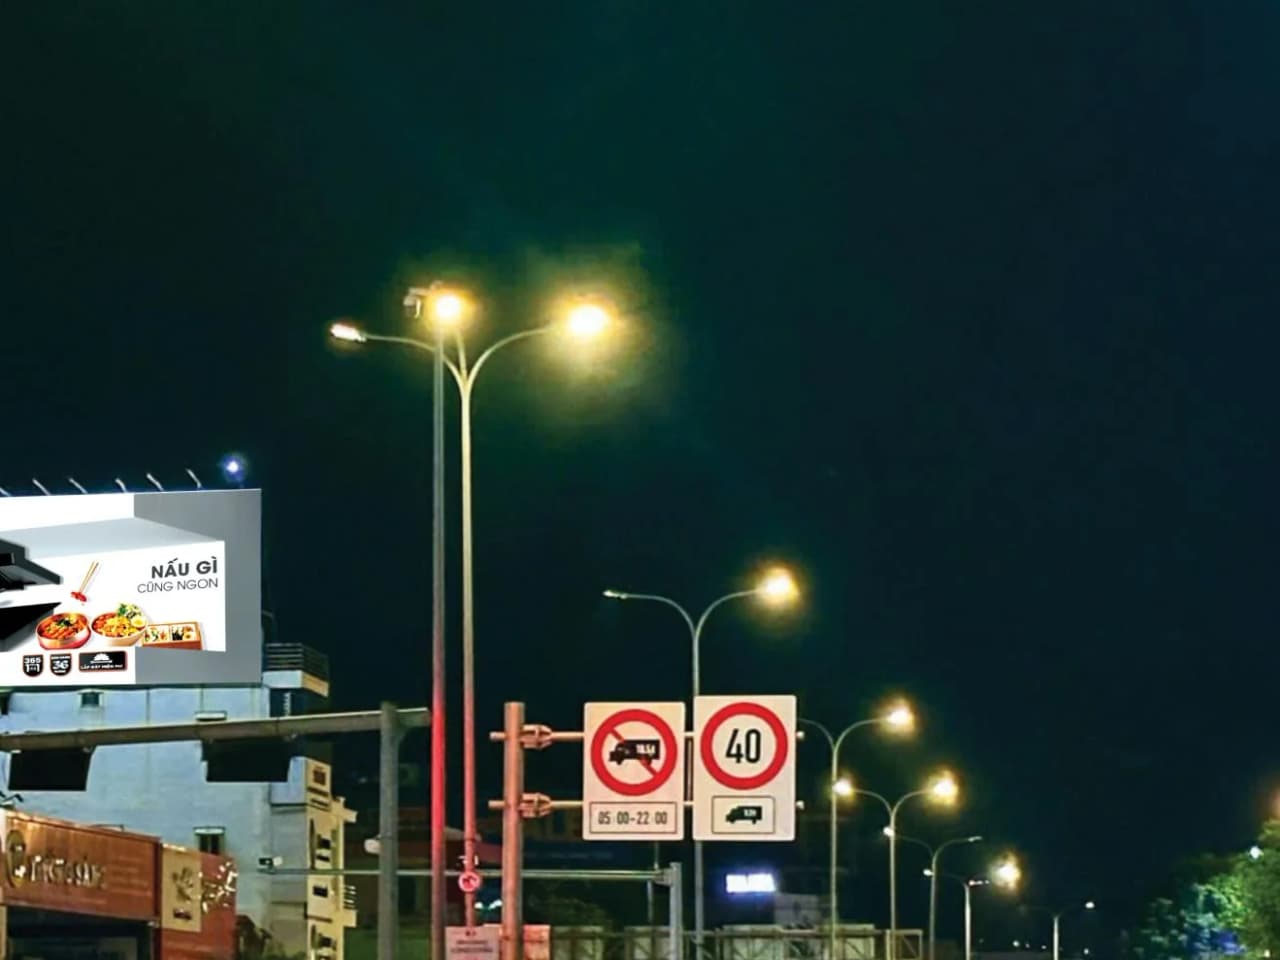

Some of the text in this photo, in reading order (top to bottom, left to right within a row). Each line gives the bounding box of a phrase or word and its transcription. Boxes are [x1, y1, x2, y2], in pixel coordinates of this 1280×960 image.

[151, 556, 218, 579] NẤU GÌ
[137, 578, 219, 594] CŨNG NGON
[725, 728, 762, 765] 40
